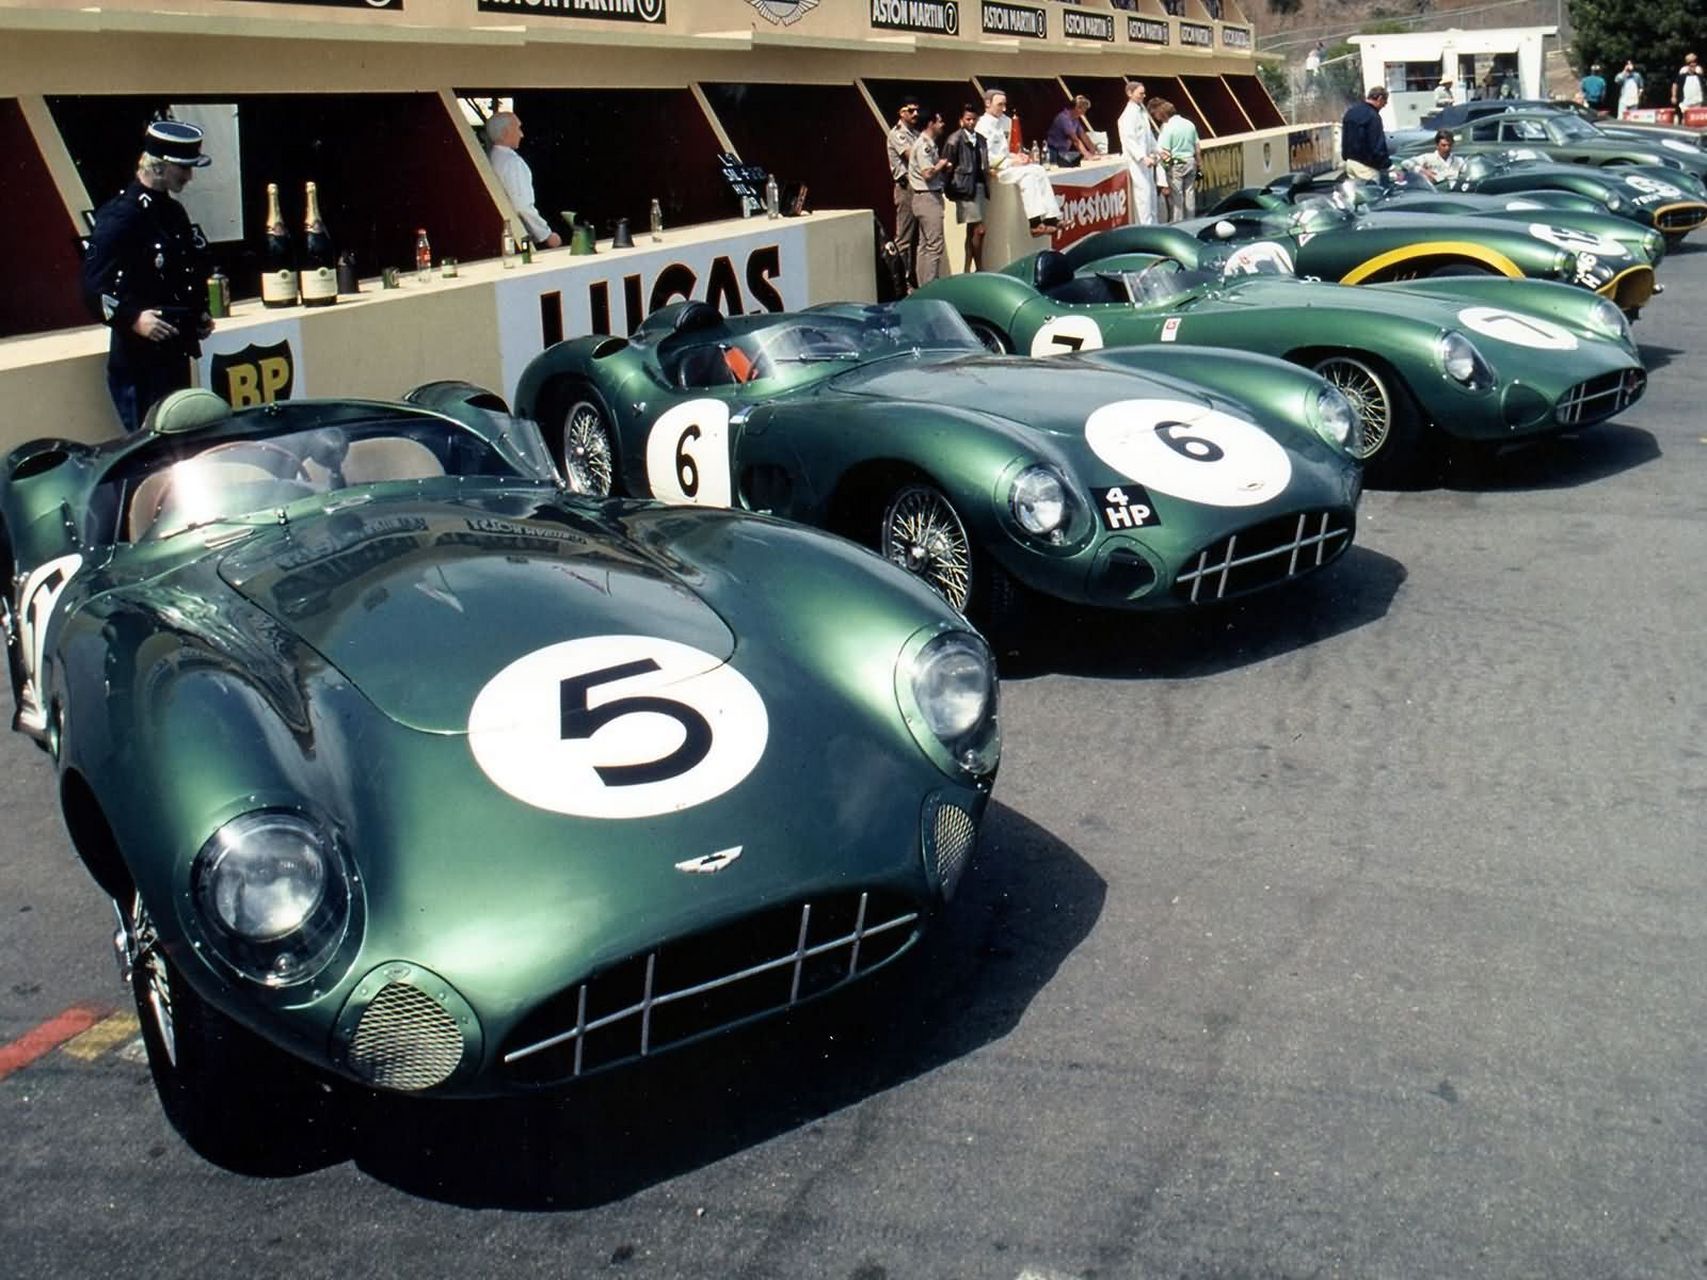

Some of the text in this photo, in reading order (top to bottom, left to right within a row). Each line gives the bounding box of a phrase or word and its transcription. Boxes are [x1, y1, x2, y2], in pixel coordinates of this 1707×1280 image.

[873, 0, 908, 24] ASTON
[909, 1, 944, 28] MARTIN
[984, 6, 1009, 30] ASTON
[1482, 315, 1556, 340] 7
[225, 356, 289, 412] BP
[1154, 420, 1224, 462] 6
[676, 424, 701, 498] 6
[1105, 487, 1129, 506] 4
[1105, 504, 1150, 529] HP
[560, 657, 713, 787] 5
